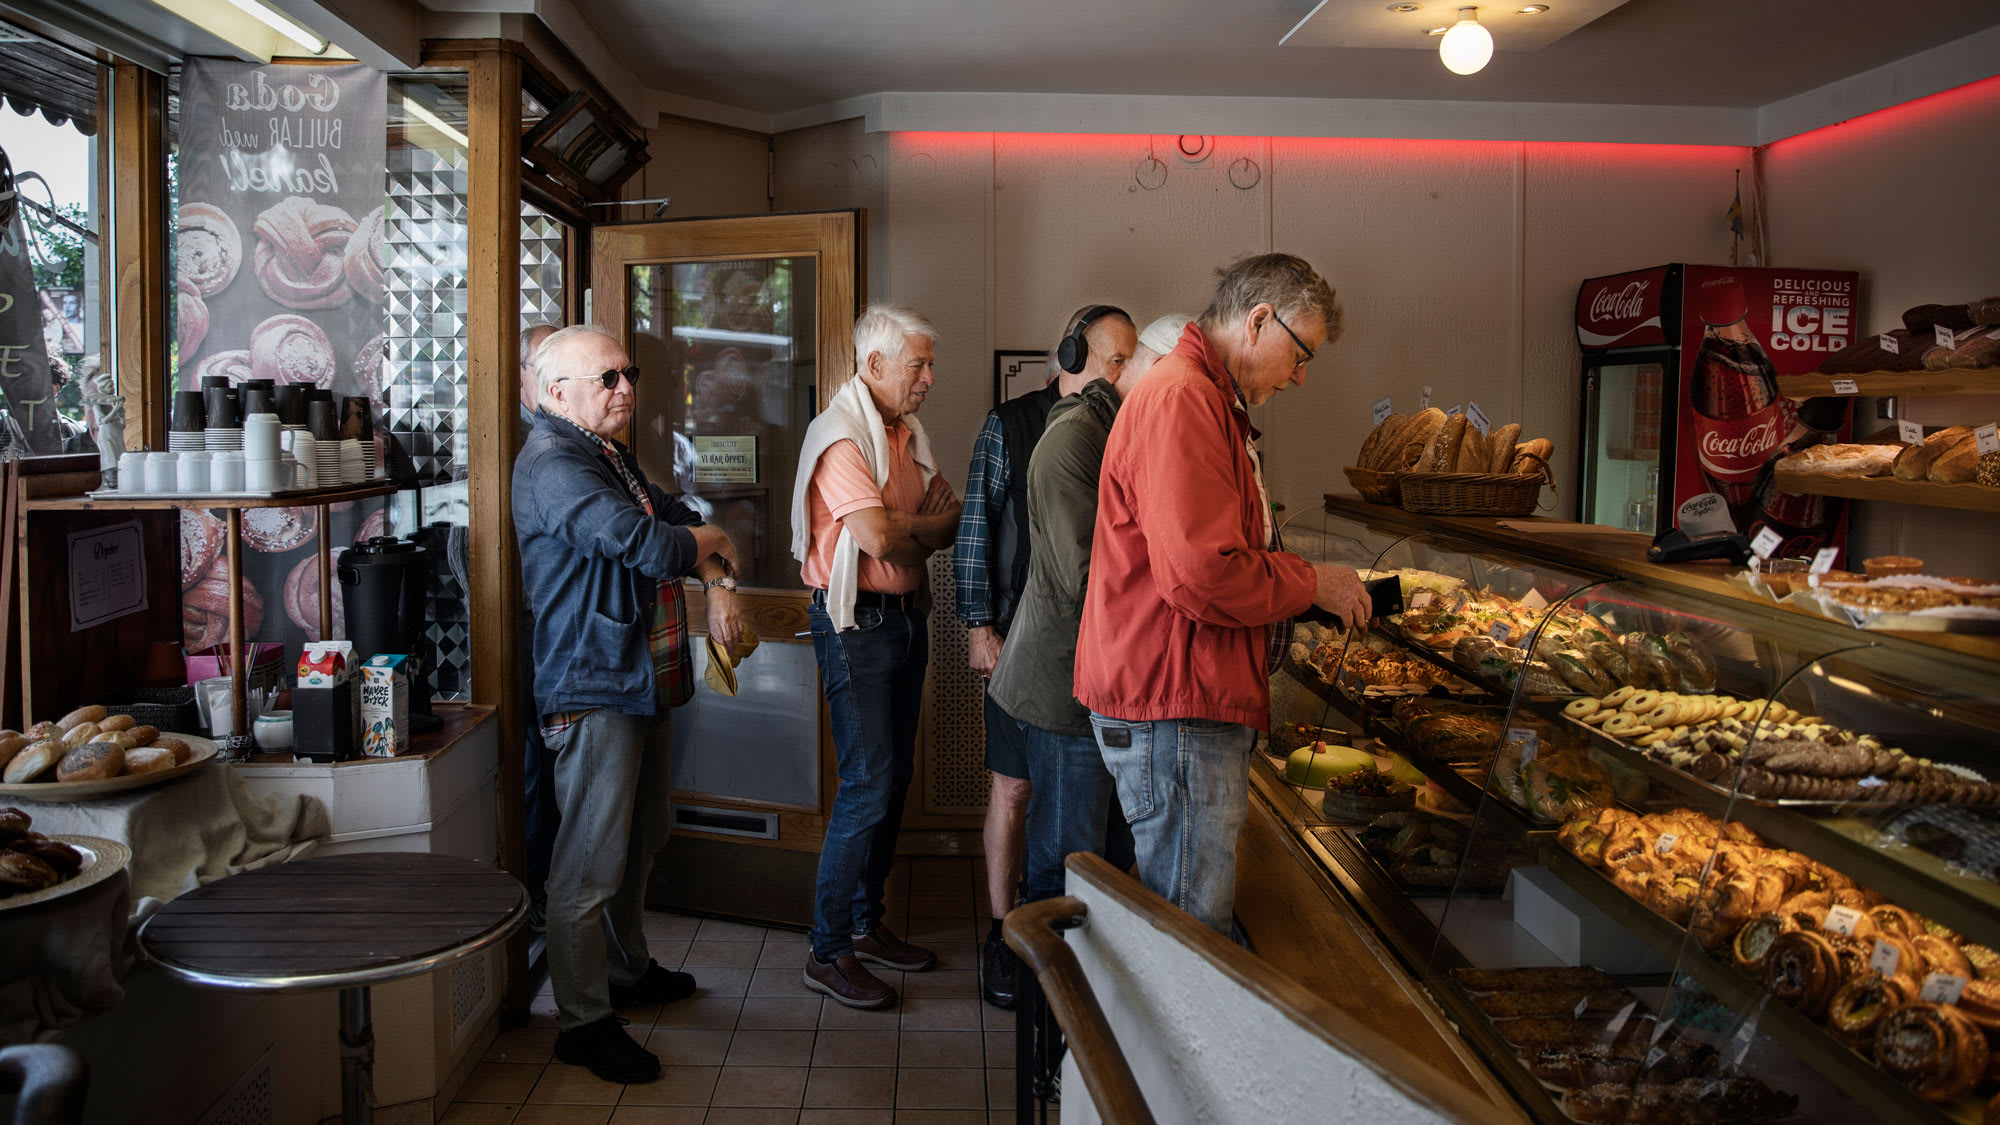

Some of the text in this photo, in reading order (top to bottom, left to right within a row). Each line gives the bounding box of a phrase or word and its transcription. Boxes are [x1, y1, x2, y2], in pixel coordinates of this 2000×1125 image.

[1773, 278, 1850, 292] DELICIOUS
[1590, 280, 1650, 322] Coca-Cola
[1773, 296, 1850, 307] REFRESHING
[1772, 305, 1850, 334] ICE
[1771, 333, 1848, 352] COLD
[1702, 412, 1778, 459] Coca-Cola
